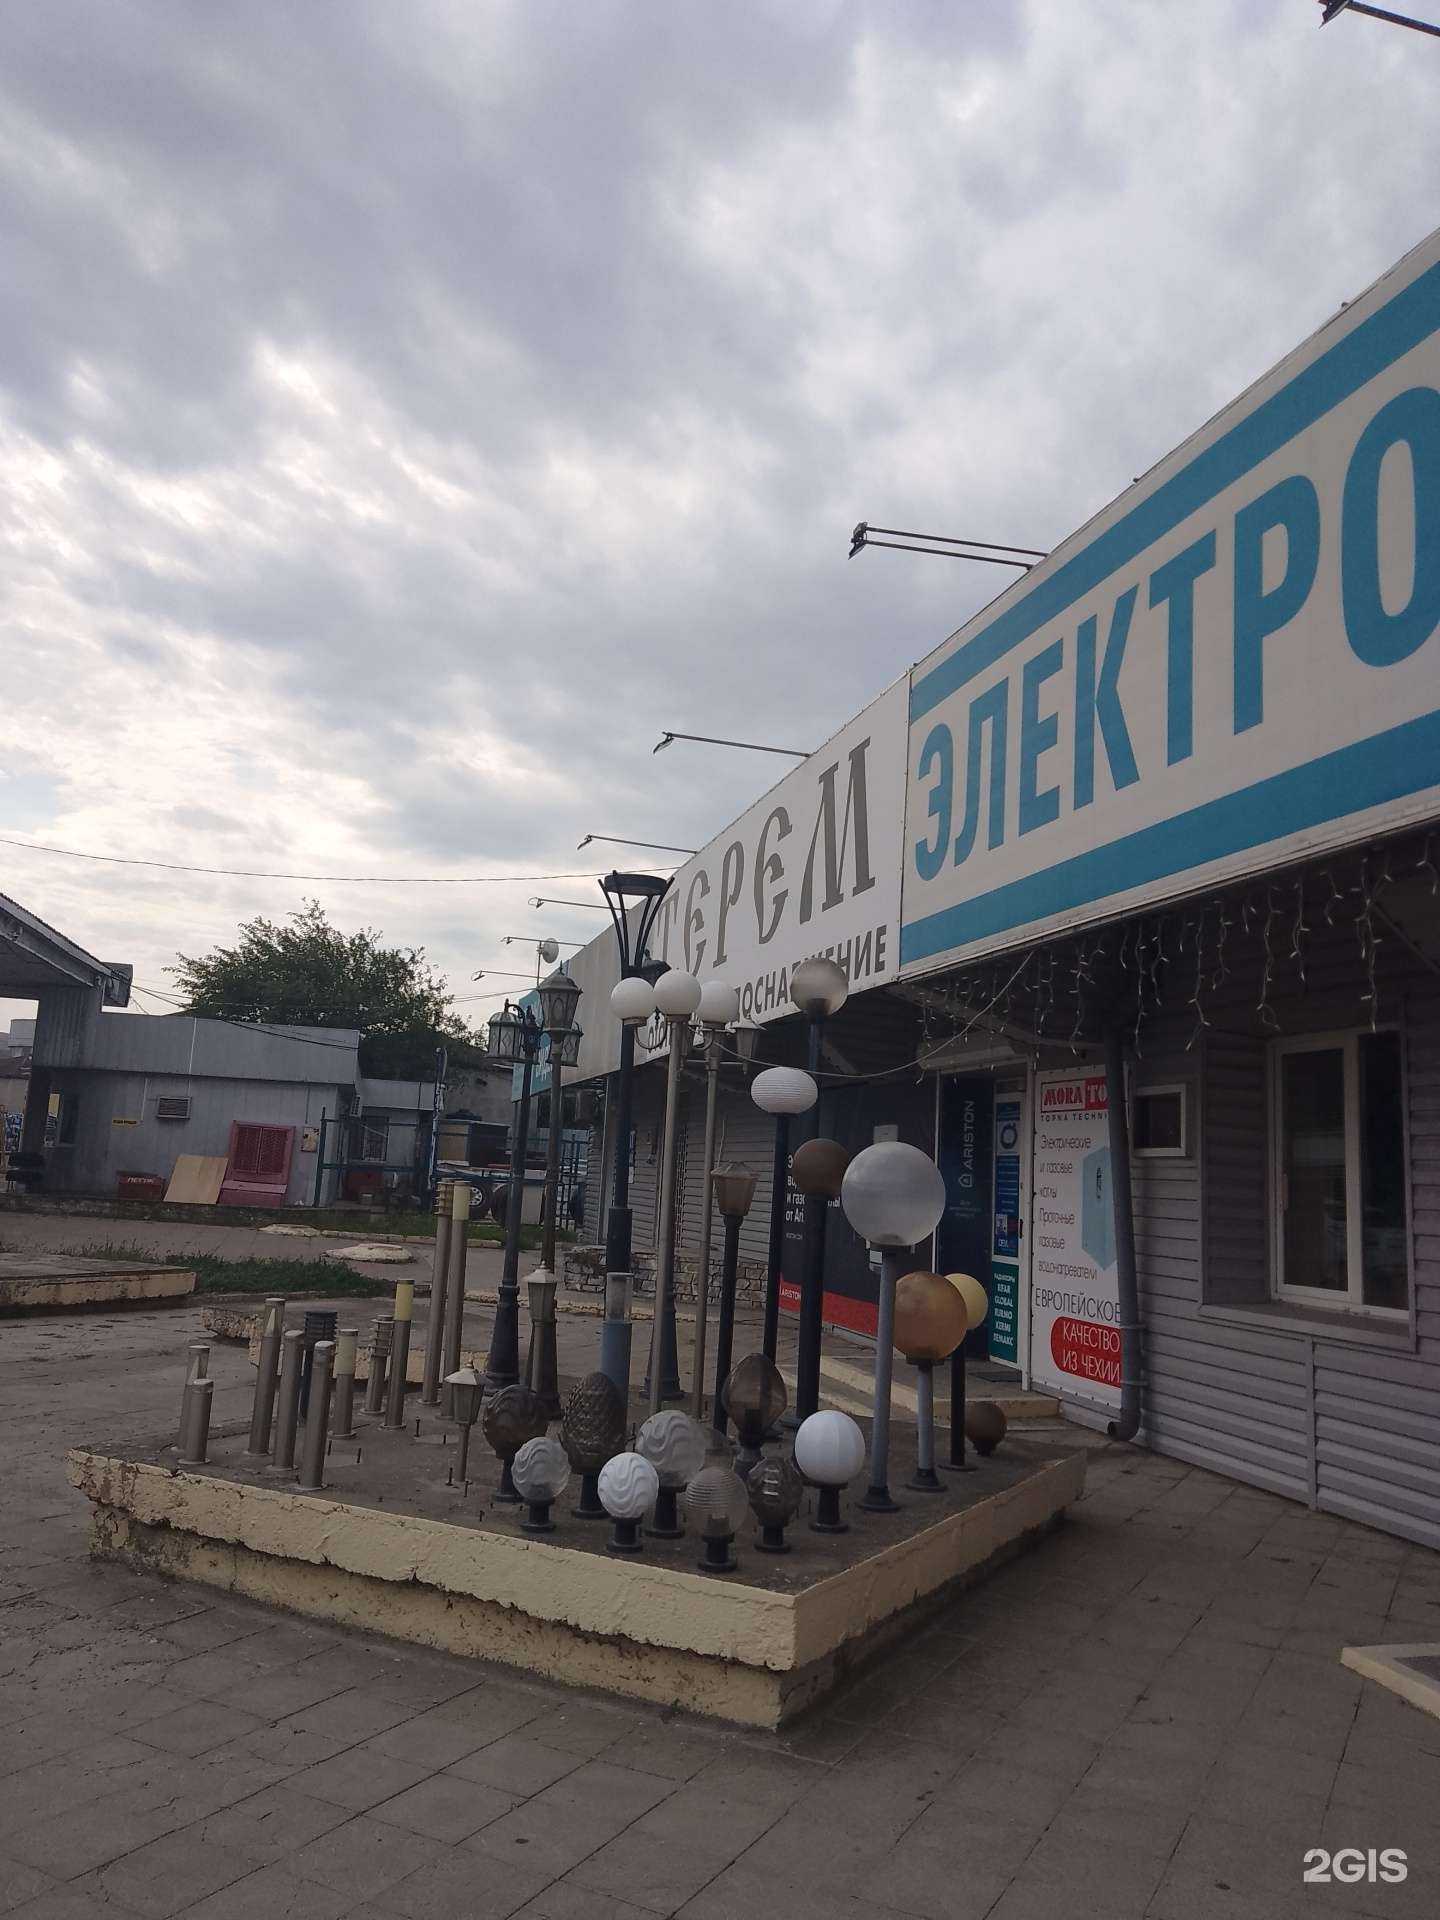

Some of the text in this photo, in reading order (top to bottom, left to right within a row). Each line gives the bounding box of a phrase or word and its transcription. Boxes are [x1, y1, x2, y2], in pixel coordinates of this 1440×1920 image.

[915, 386, 1440, 881] ЭЛЕКТРО
[1043, 1084, 1108, 1106] MORA TO
[1073, 1112, 1108, 1121] TECHNI
[963, 1100, 975, 1170] ARISTON
[1035, 1288, 1120, 1323] ЕВРОПЕЙСКОЕ
[1063, 1321, 1120, 1353] КАЧЕСТВО
[1063, 1349, 1120, 1384] ИЗ ЧЕХИИ
